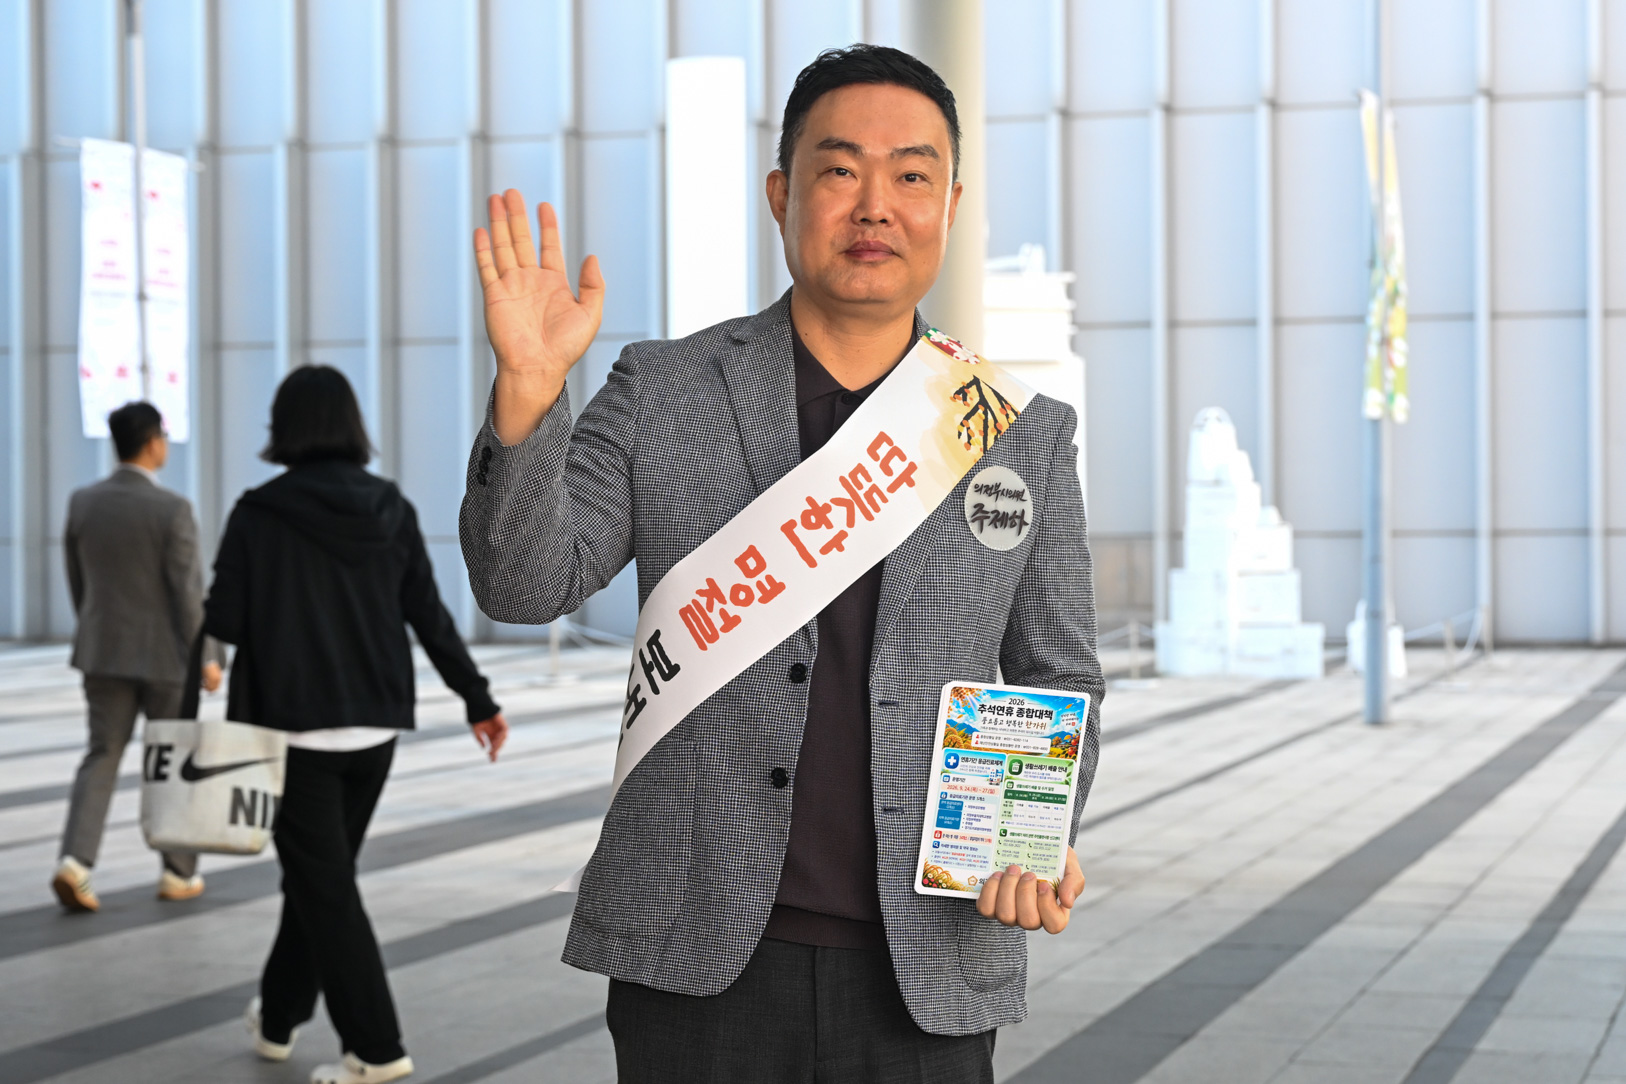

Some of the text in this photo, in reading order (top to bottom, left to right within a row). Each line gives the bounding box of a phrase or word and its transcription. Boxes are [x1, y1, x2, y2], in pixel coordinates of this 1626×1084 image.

[780, 430, 918, 568] 따뜻한
[678, 544, 786, 651] 명절
[1008, 698, 1025, 706] 2026
[977, 704, 1015, 717] 추석연휴
[1015, 707, 1054, 721] 종합대책
[981, 716, 1047, 730] 풍요롭고 행복한 한가위
[1024, 763, 1048, 771] 생활쓰레기
